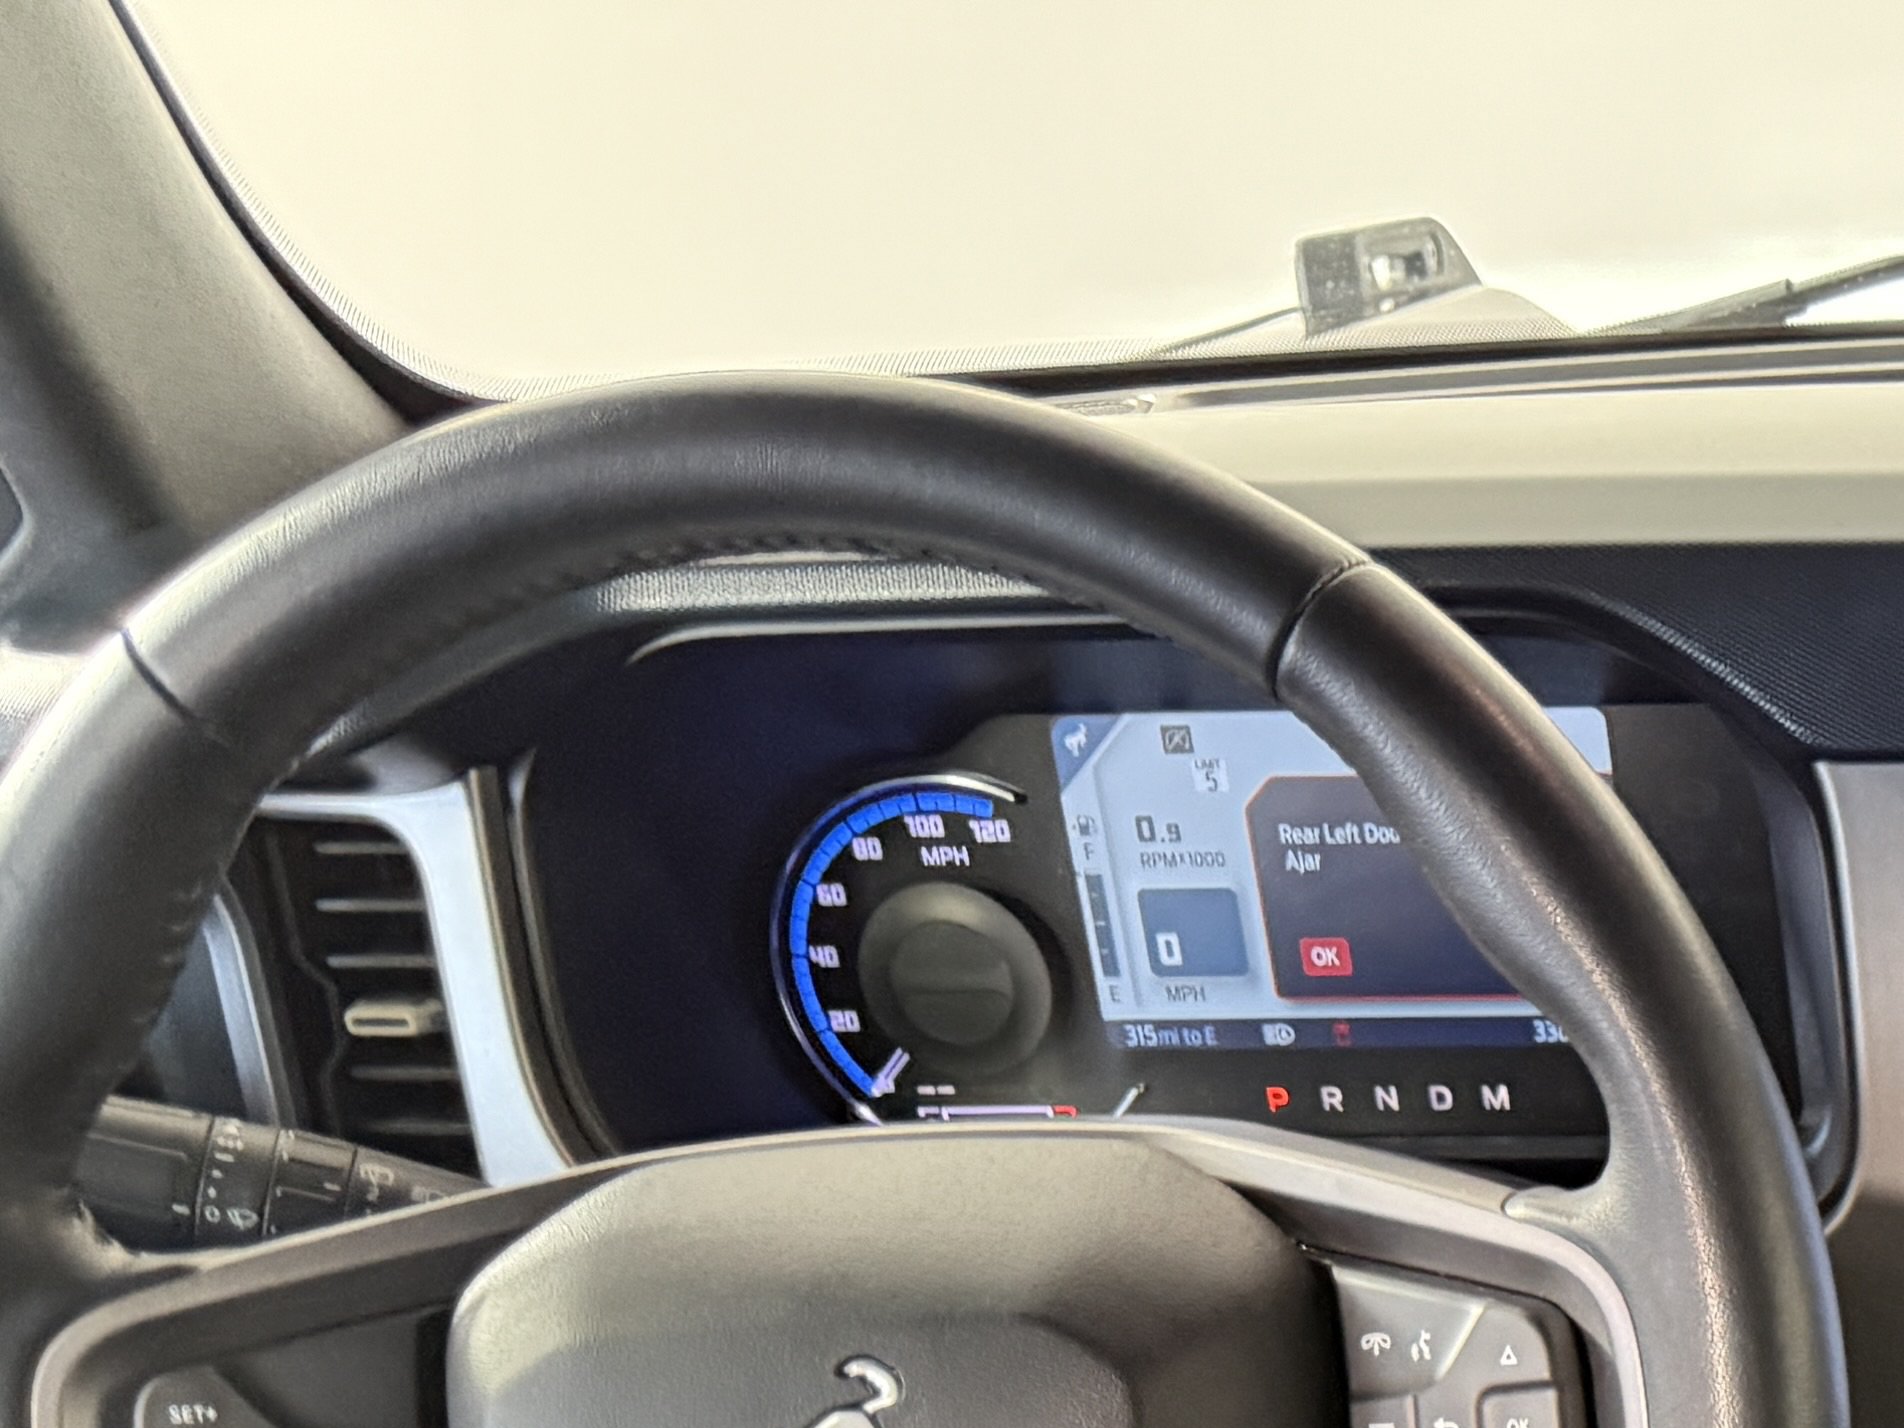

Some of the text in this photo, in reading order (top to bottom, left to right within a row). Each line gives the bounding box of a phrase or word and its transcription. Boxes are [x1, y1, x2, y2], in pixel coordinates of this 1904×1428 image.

[1205, 770, 1218, 792] 5
[903, 815, 945, 839] 100
[968, 819, 1011, 843] 120
[1135, 815, 1182, 843] 0.9
[1279, 821, 1400, 845] Rear Left Doo
[920, 847, 970, 868] MPH
[1083, 842, 1096, 861] F
[1285, 849, 1320, 876] Ajar
[809, 945, 840, 969] 40
[1155, 932, 1183, 966] 0
[1310, 946, 1340, 968] OK
[1109, 985, 1121, 1002] E
[1166, 985, 1206, 1002] MPH
[829, 1010, 860, 1032] 20
[1266, 1085, 1511, 1113] P R N D M
